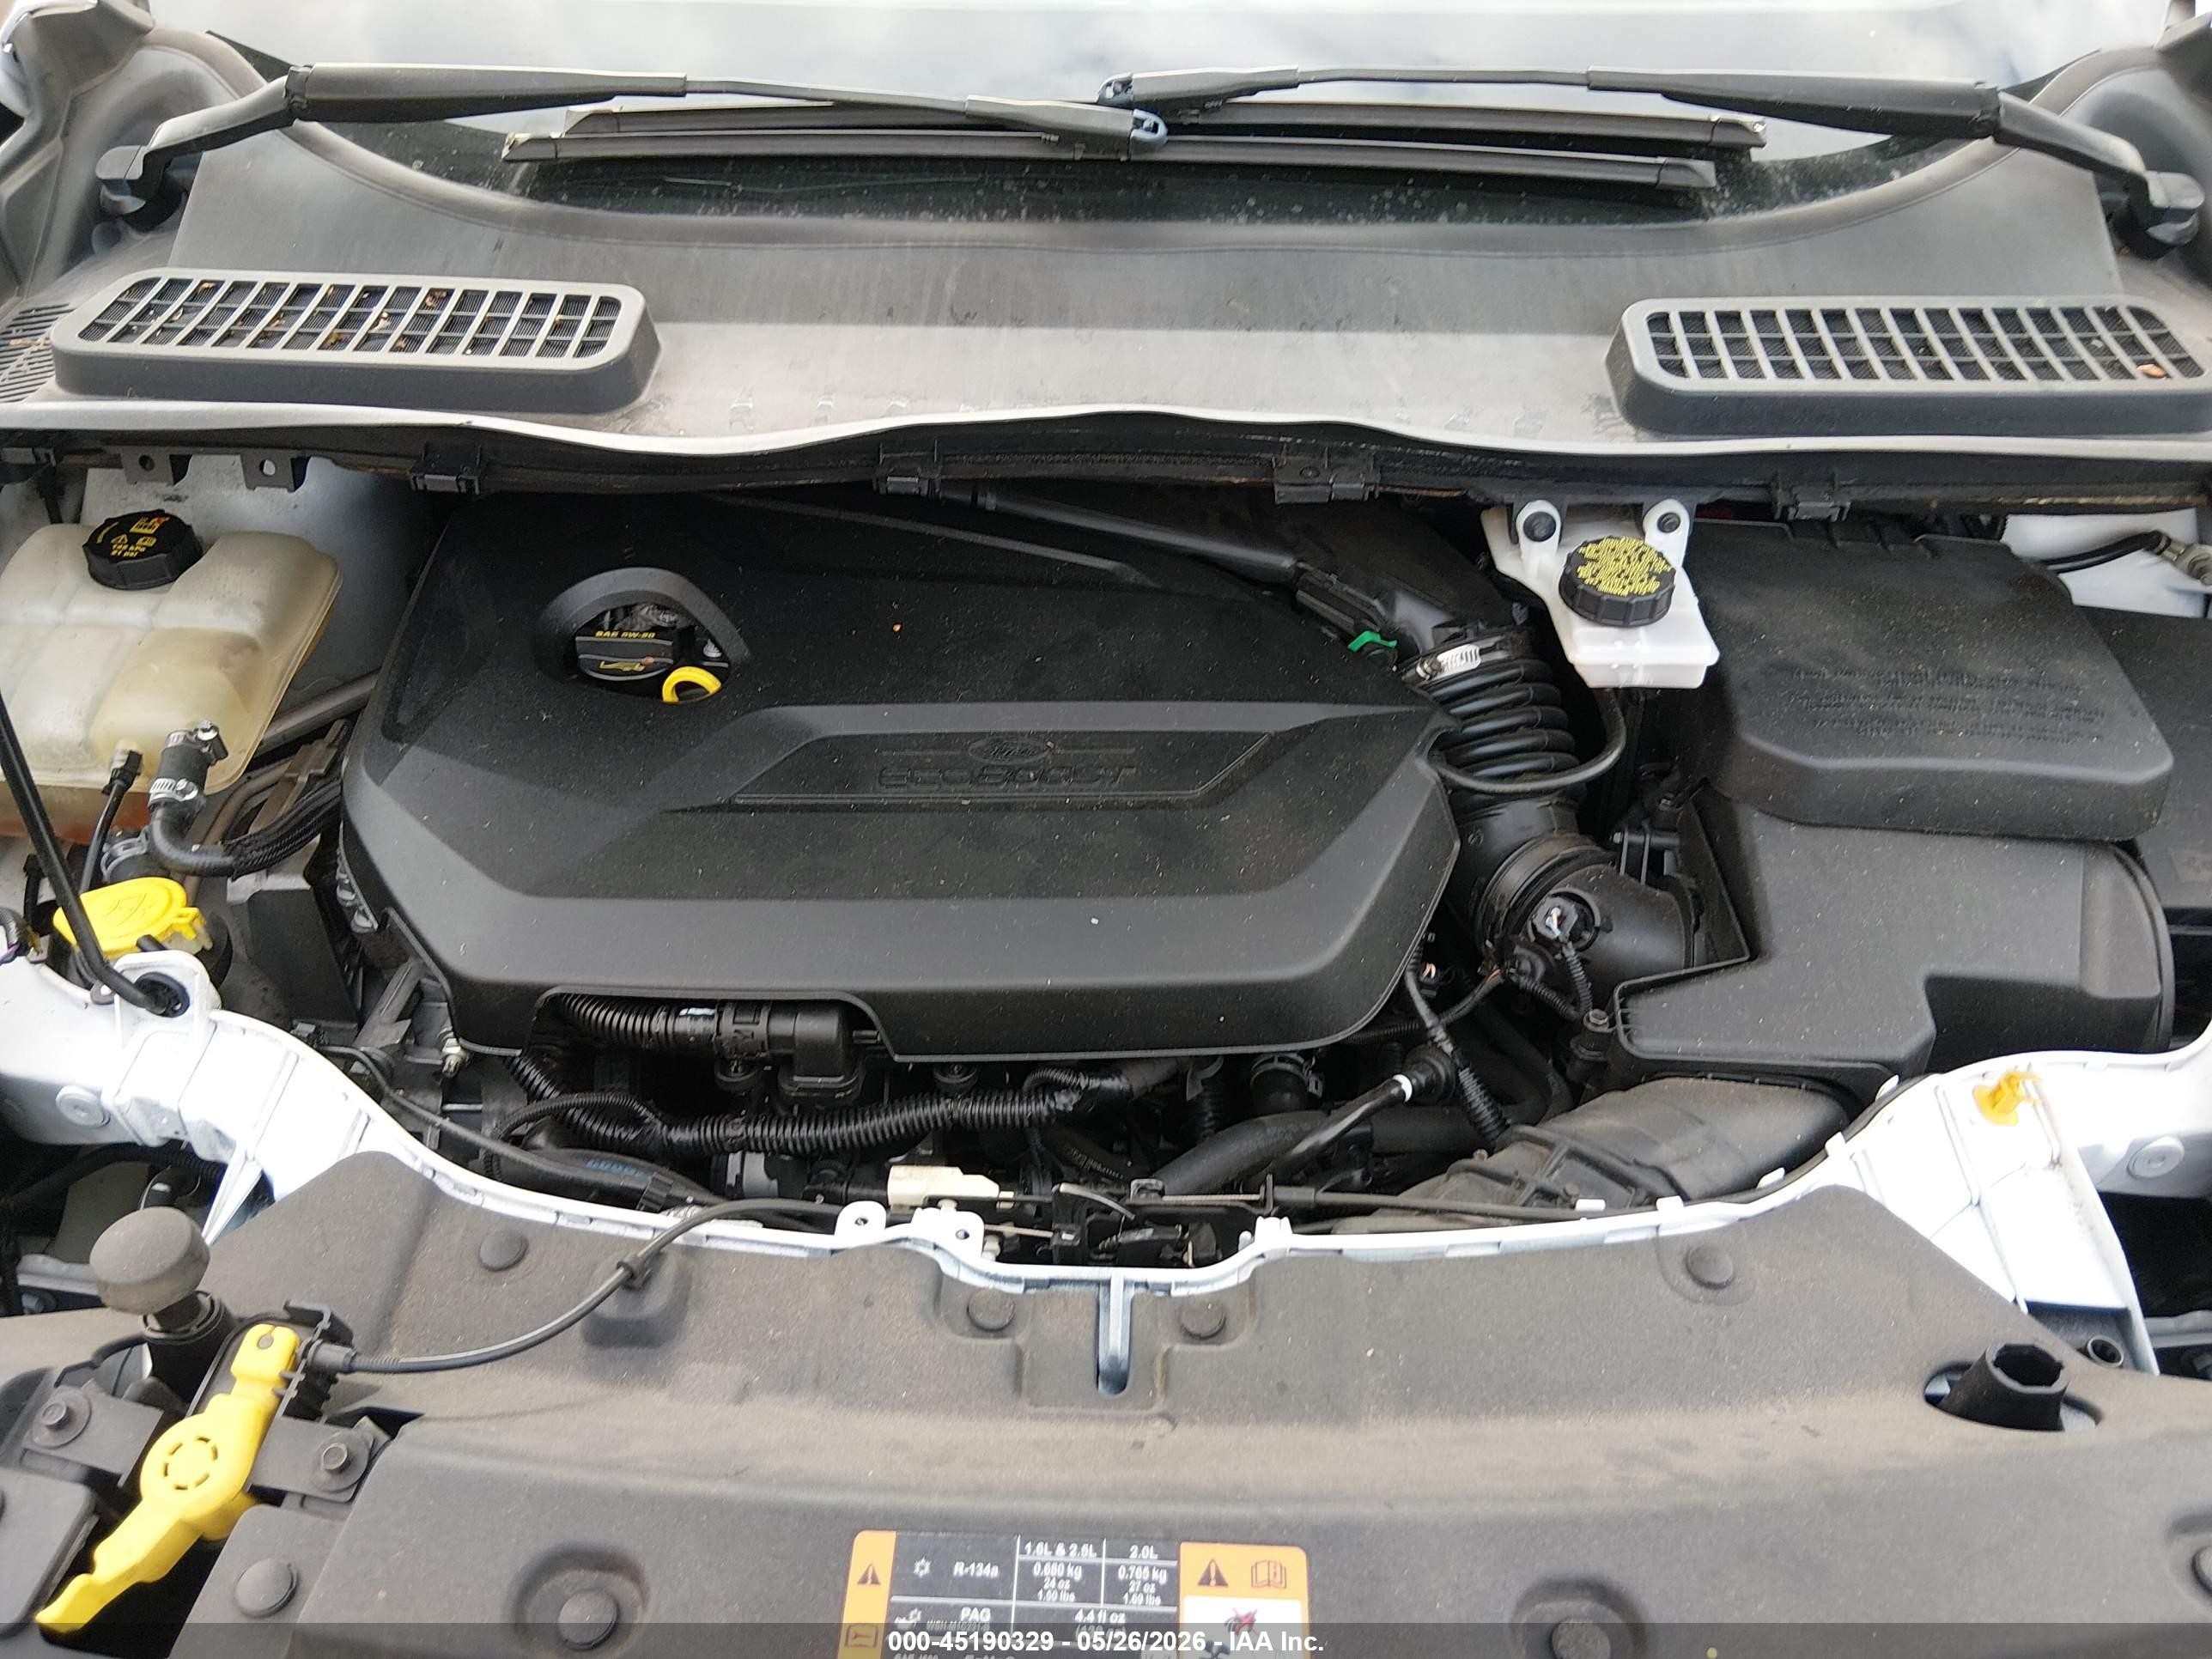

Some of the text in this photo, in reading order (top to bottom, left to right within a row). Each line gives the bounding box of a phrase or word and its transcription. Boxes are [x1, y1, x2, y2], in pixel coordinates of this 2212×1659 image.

[1129, 1545, 1158, 1559] 2.0L
[953, 1561, 1000, 1577] R-134a
[1066, 1562, 1083, 1583] kg
[1152, 1565, 1168, 1585] kg
[1057, 1579, 1071, 1590] oz
[1143, 1582, 1156, 1594] oz
[960, 1607, 992, 1621] PAG
[1109, 1612, 1126, 1624] oz
